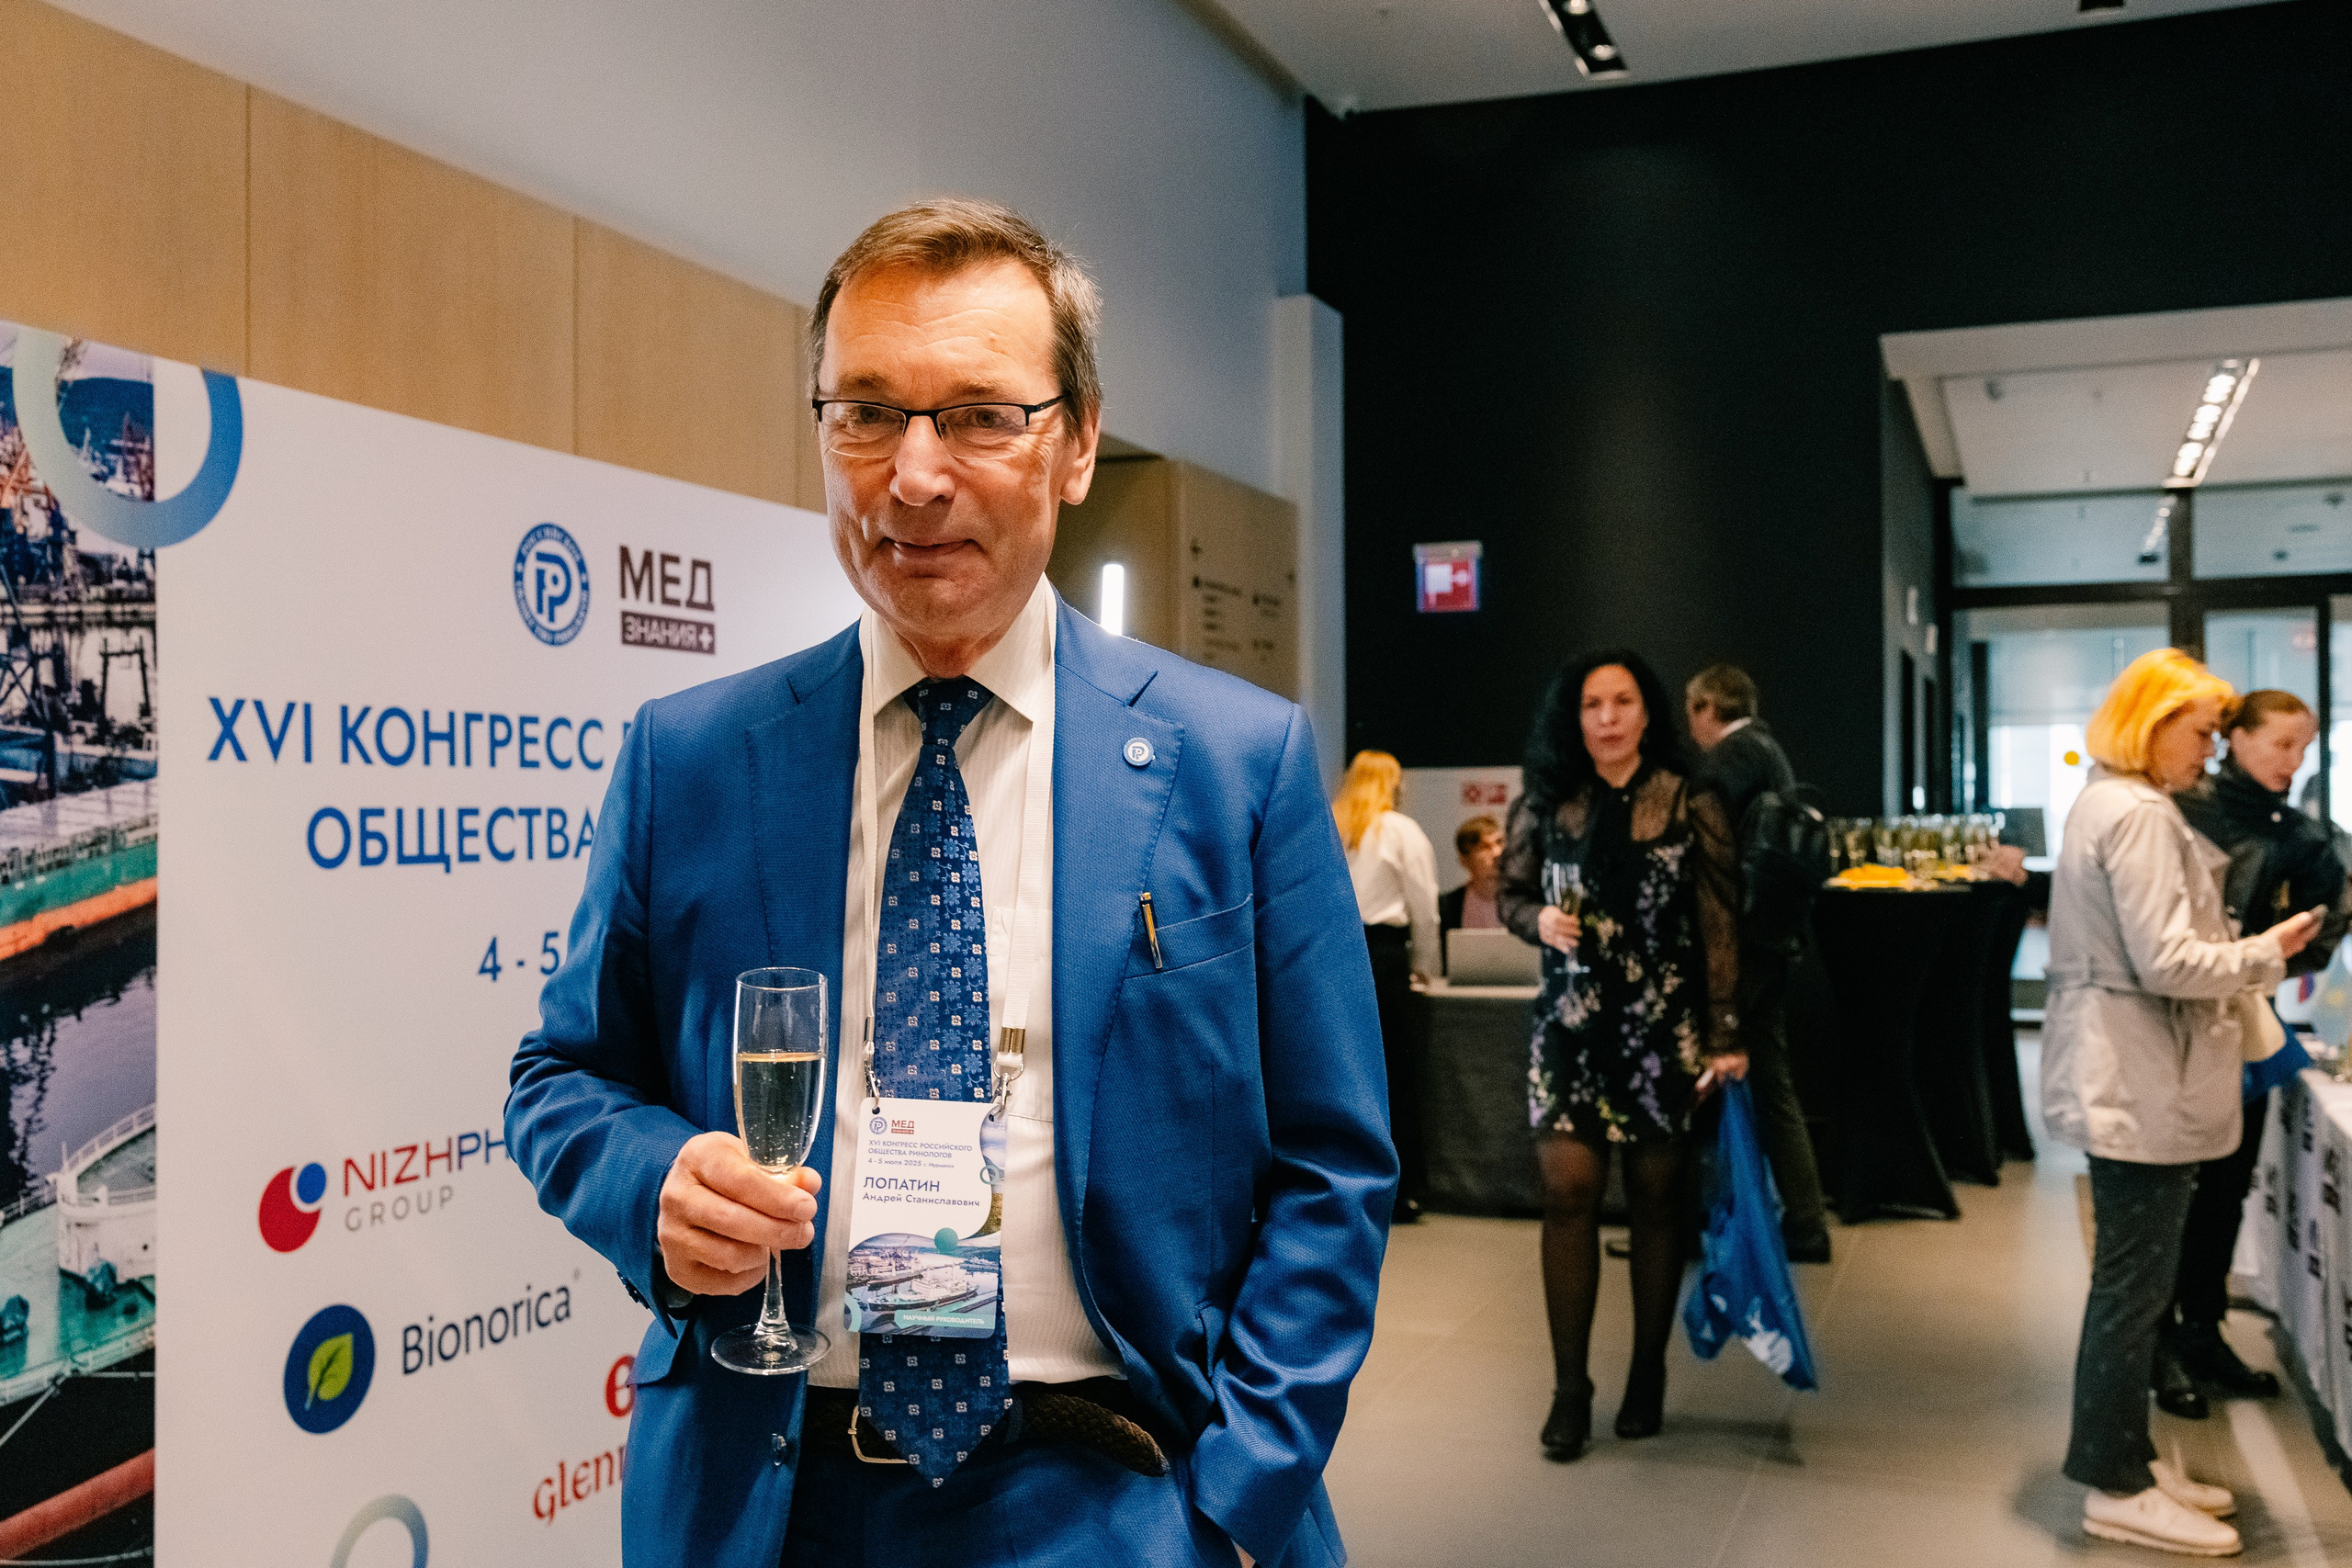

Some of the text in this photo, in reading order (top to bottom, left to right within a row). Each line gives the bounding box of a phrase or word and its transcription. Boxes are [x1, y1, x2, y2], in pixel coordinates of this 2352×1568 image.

[619, 544, 715, 613] МЕД
[208, 696, 604, 770] XVI КОНГРЕСС
[307, 807, 595, 874] ОБЩЕСТВА
[478, 935, 502, 982] 4
[540, 931, 560, 976] 5
[891, 1119, 915, 1129] МЕД
[868, 1147, 952, 1158] ОБЩЕСТВА РИНОЛОГОВ
[882, 1140, 918, 1148] КОНГРЕСС
[920, 1142, 973, 1152] РОССИЙСКОГО
[863, 1192, 980, 1206] Андрей Станиславович
[864, 1177, 940, 1192] ЛОПАТИН
[345, 1185, 454, 1232] GROUP
[402, 1283, 571, 1376] Bionorica
[903, 1314, 985, 1325] НАУЧНЫЙ РУКОВОДИТЕЛЬ
